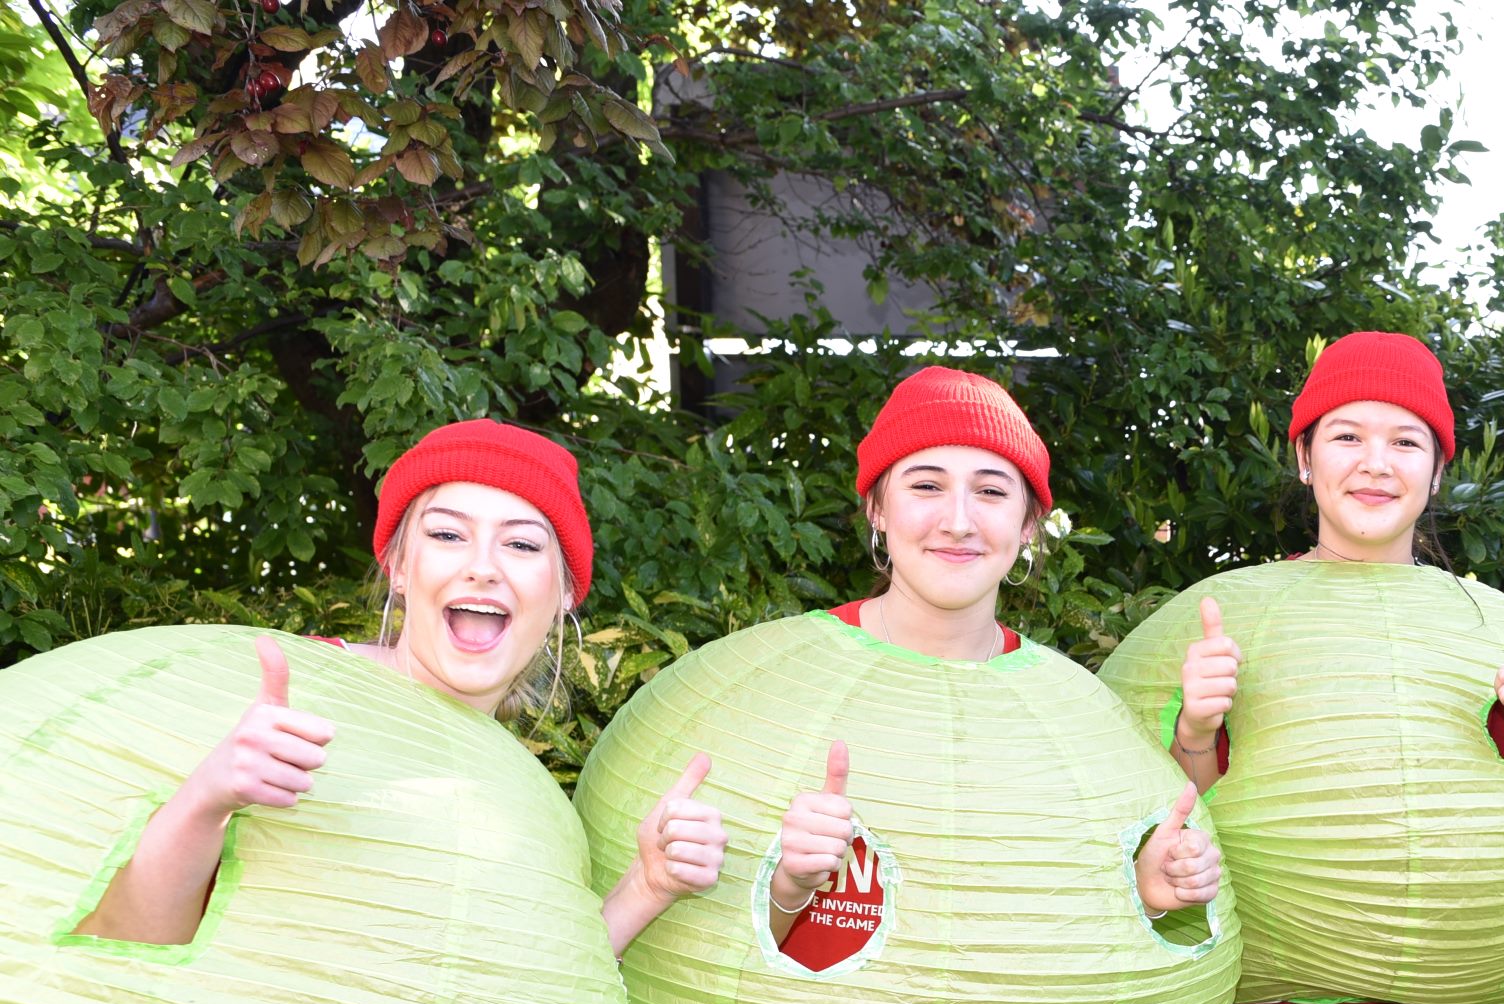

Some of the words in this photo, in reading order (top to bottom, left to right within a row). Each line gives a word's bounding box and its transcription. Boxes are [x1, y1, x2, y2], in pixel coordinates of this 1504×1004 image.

[822, 898, 884, 917] INVENTED
[809, 911, 834, 926] THE
[836, 916, 875, 931] GAME
